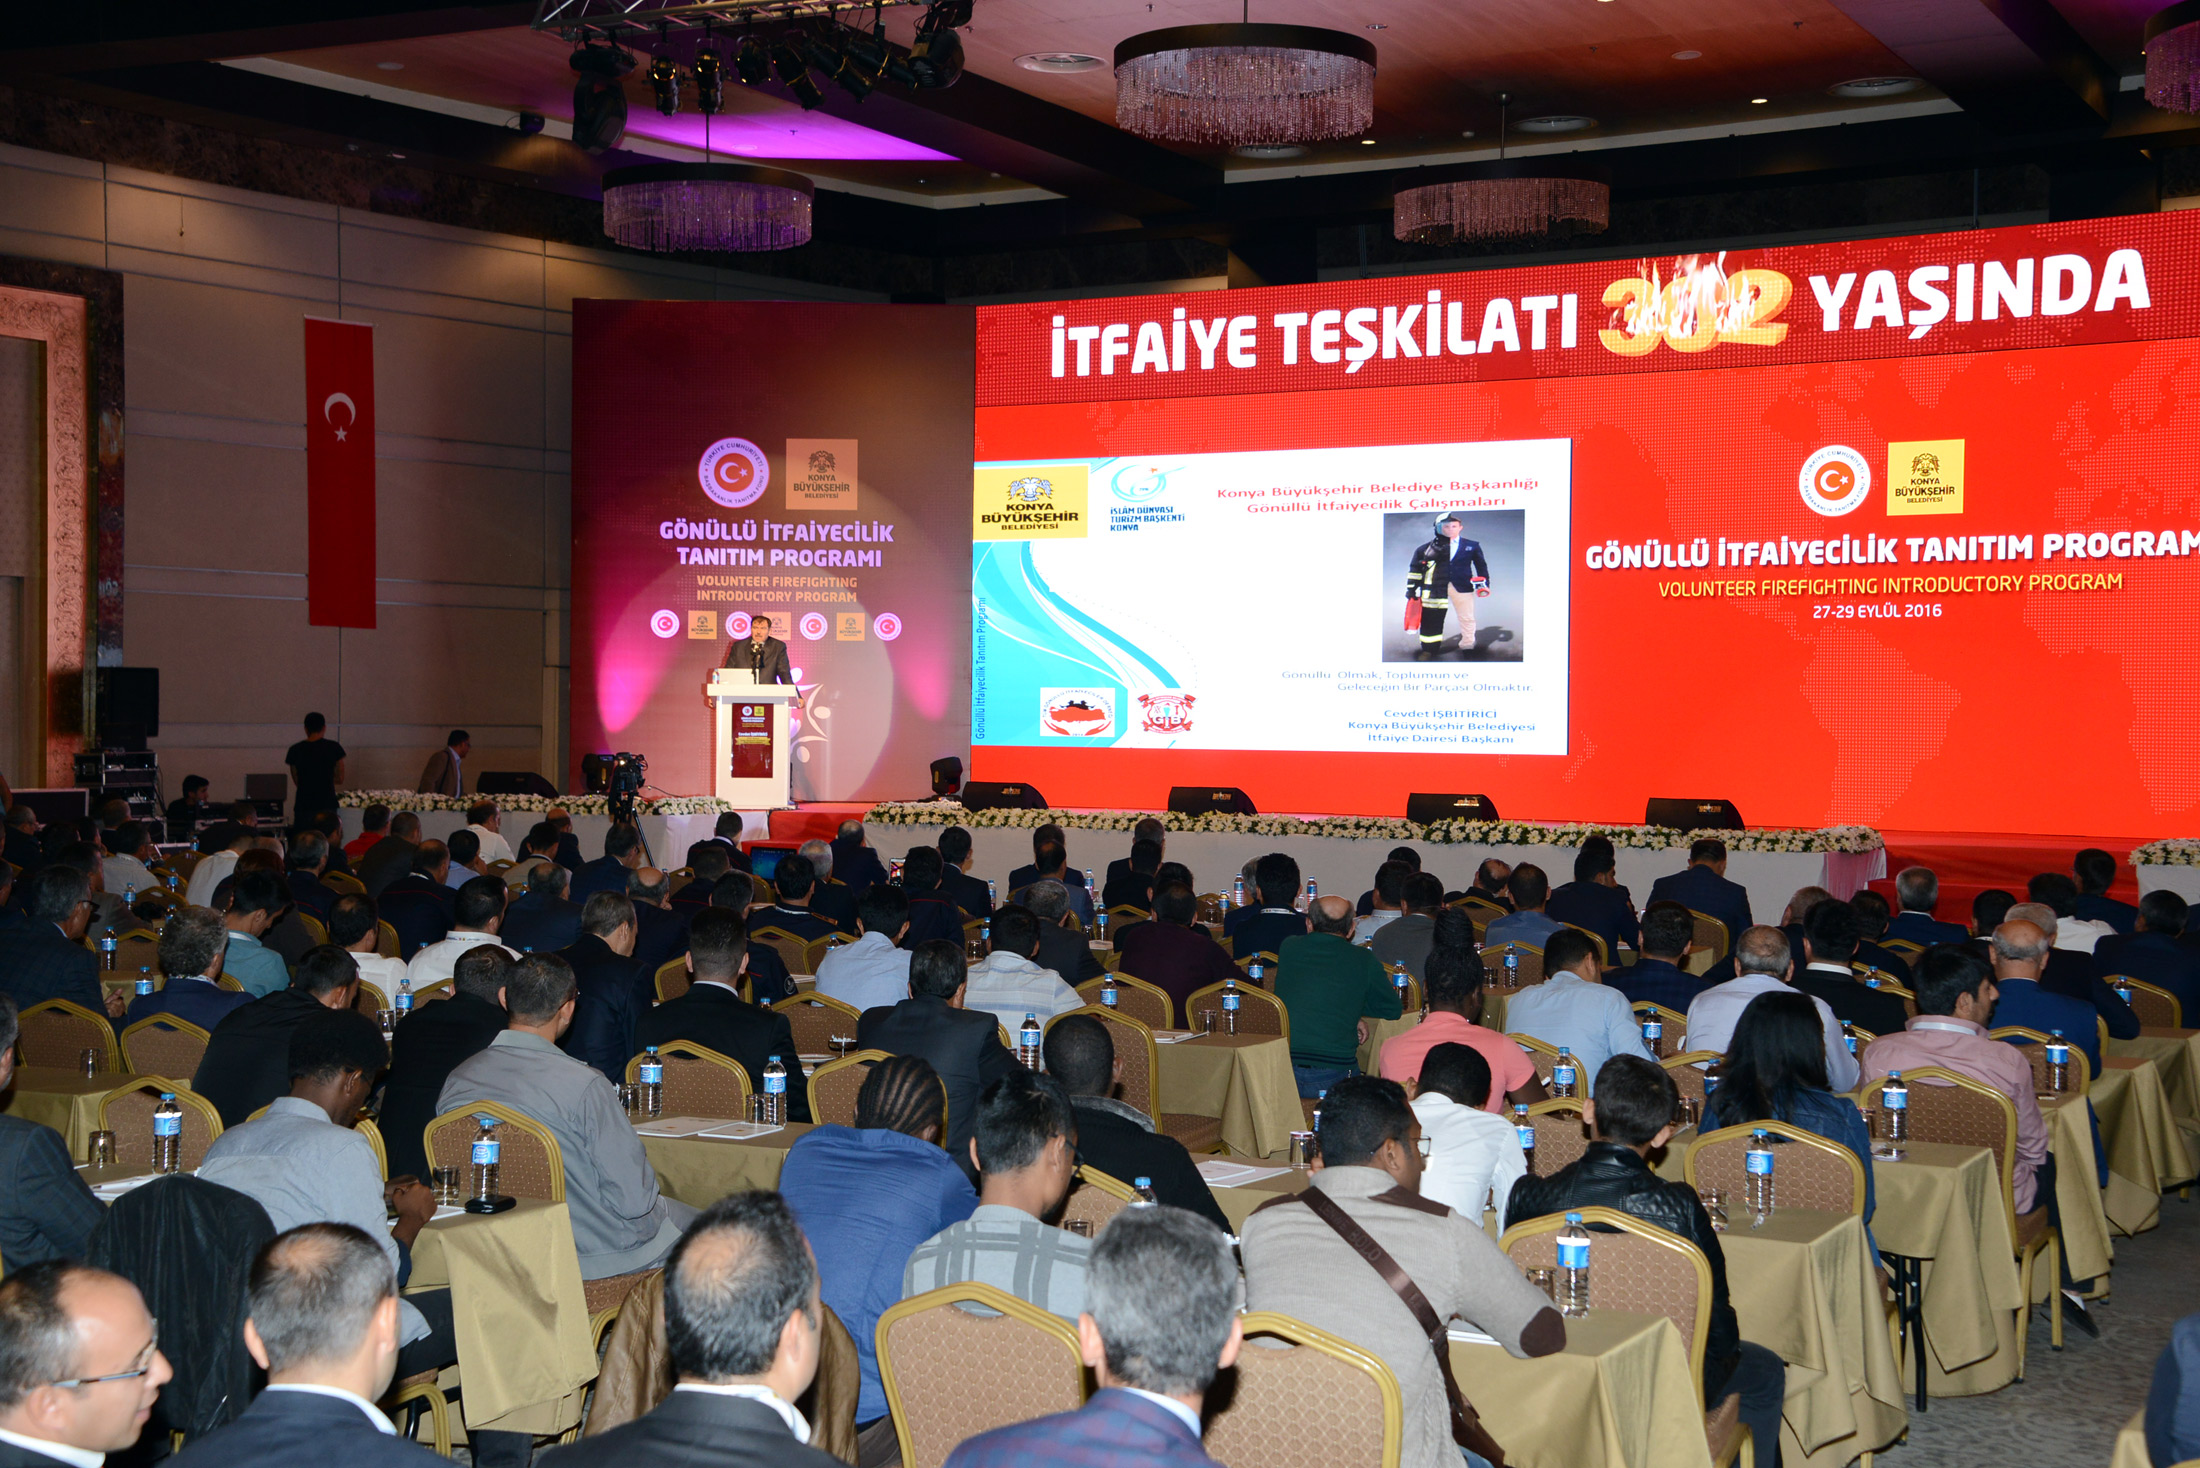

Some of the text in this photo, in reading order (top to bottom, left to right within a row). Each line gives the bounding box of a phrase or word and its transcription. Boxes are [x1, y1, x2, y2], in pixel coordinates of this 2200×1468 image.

[1051, 308, 1257, 378] İTFAİYE
[1273, 290, 1578, 374] TEŞKİLATI
[1808, 248, 2152, 339] YAŞINDA
[793, 481, 850, 492] BÜYÜKŞEHİR
[1217, 478, 1538, 499] Konya Büyükşehir Belediye Başkanlığı
[1910, 478, 1941, 486] KONYA
[1895, 484, 1955, 497] BÜYÜKŞEHİR
[1006, 503, 1054, 512] KONYA
[1137, 505, 1174, 513] DÜNYASI
[1247, 497, 1506, 513] Gönüllü İtfaiyecilik Çalışmaları
[981, 510, 1079, 524] BÜYÜKŞEHİR
[1110, 513, 1185, 523] TURİZM BAŞKENTİ
[659, 518, 894, 542] GÖNÜLLÜ İTFAİYECİLİK
[1110, 524, 1139, 532] KONYA
[676, 546, 882, 567] TANITIM PROGRAMI
[1586, 537, 1709, 569] GÖNÜLLÜ
[1718, 533, 1898, 567] İTFAİYECİLİK
[1906, 534, 2033, 563] TANITIM
[696, 575, 858, 588] VOLUNTEER FIREFIGHTING
[1659, 572, 2123, 598] VOLUNTEER FIREFIGHTING INTRODUCTORY PROGRAM
[696, 590, 857, 603] INTRODUCTORY PROGRAM
[1813, 602, 1942, 619] 27-29 EYLÜL 2016
[976, 635, 986, 665] Tanıtım
[1385, 671, 1450, 680] Toplumun
[1384, 708, 1497, 719] Cevdet İŞBİTİRİCİ
[1348, 721, 1536, 732] Konya Büyükşehir Belediyesi
[1368, 732, 1514, 744] İtfaiye Dairesi Başkanı
